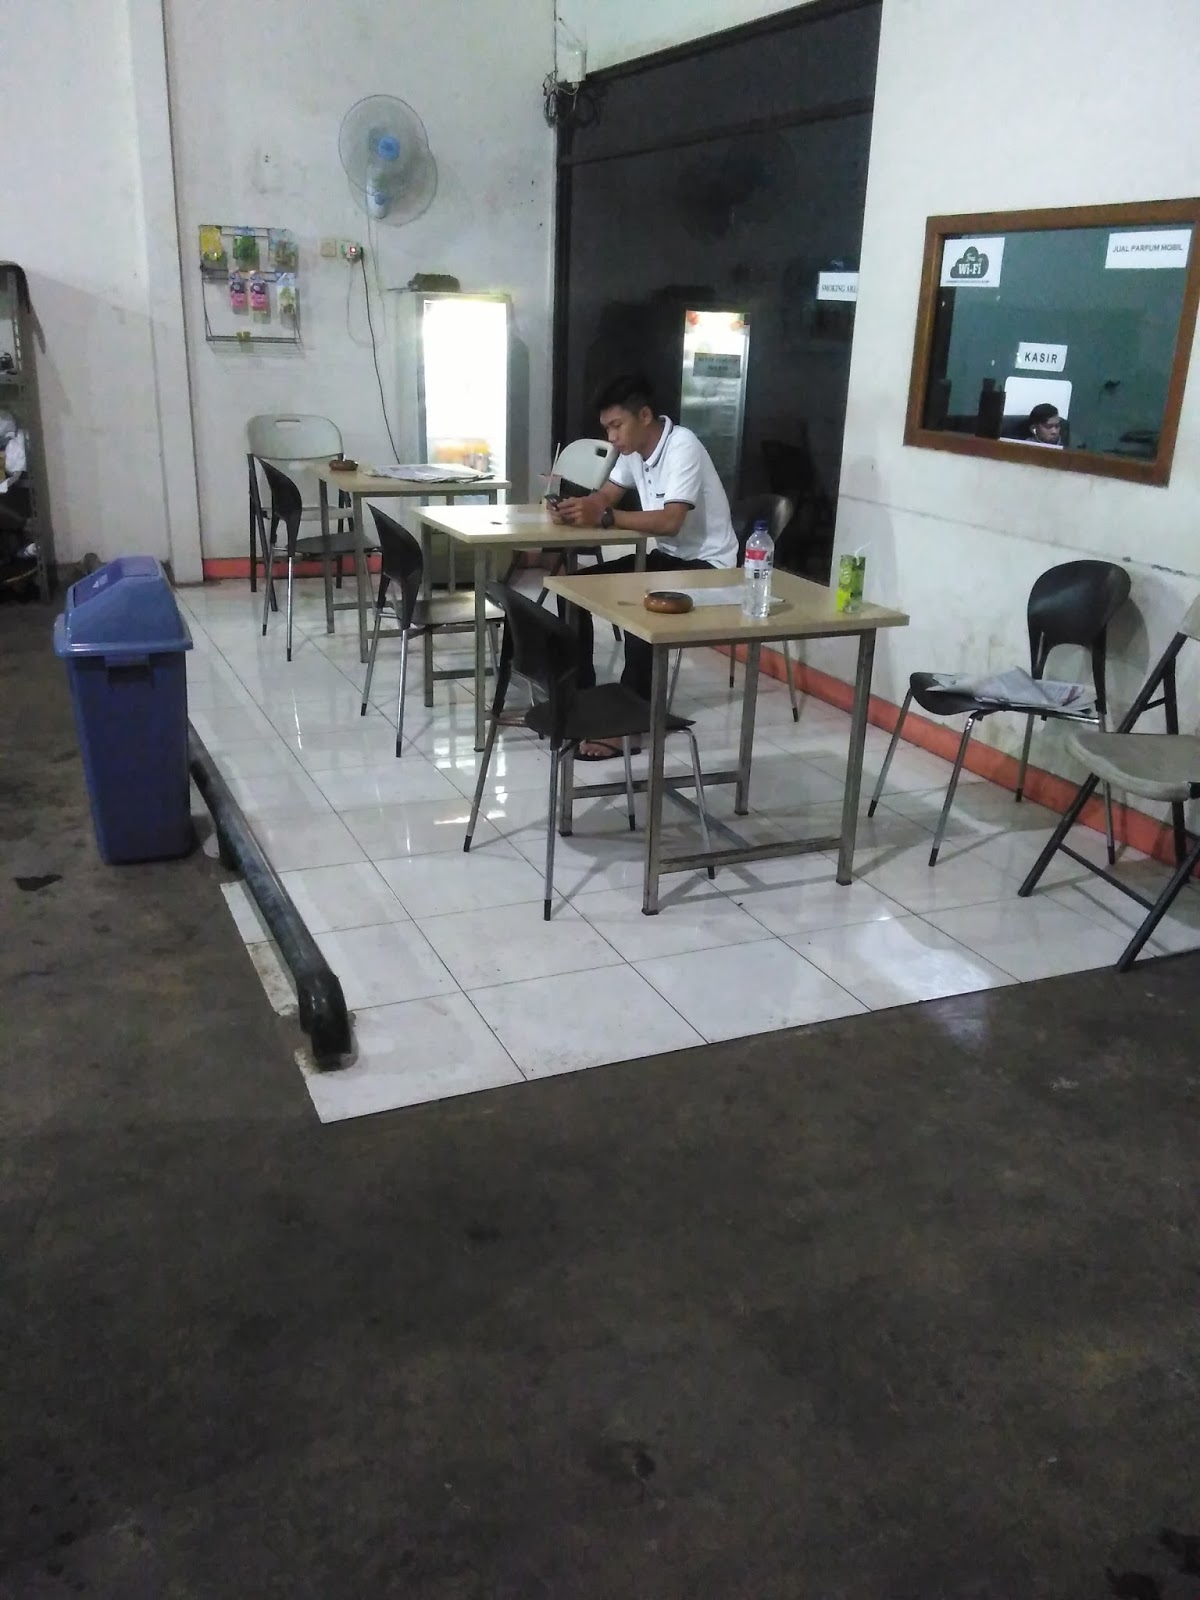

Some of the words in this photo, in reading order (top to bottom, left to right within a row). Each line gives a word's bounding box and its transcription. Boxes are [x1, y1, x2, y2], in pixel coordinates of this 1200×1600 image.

[1112, 245, 1129, 253] JUAL
[1130, 244, 1160, 252] PARFUM
[1160, 243, 1184, 251] MOBIL
[958, 263, 982, 275] Wi-Fi
[821, 284, 846, 293] SMOKING
[1024, 352, 1058, 364] KASIR
